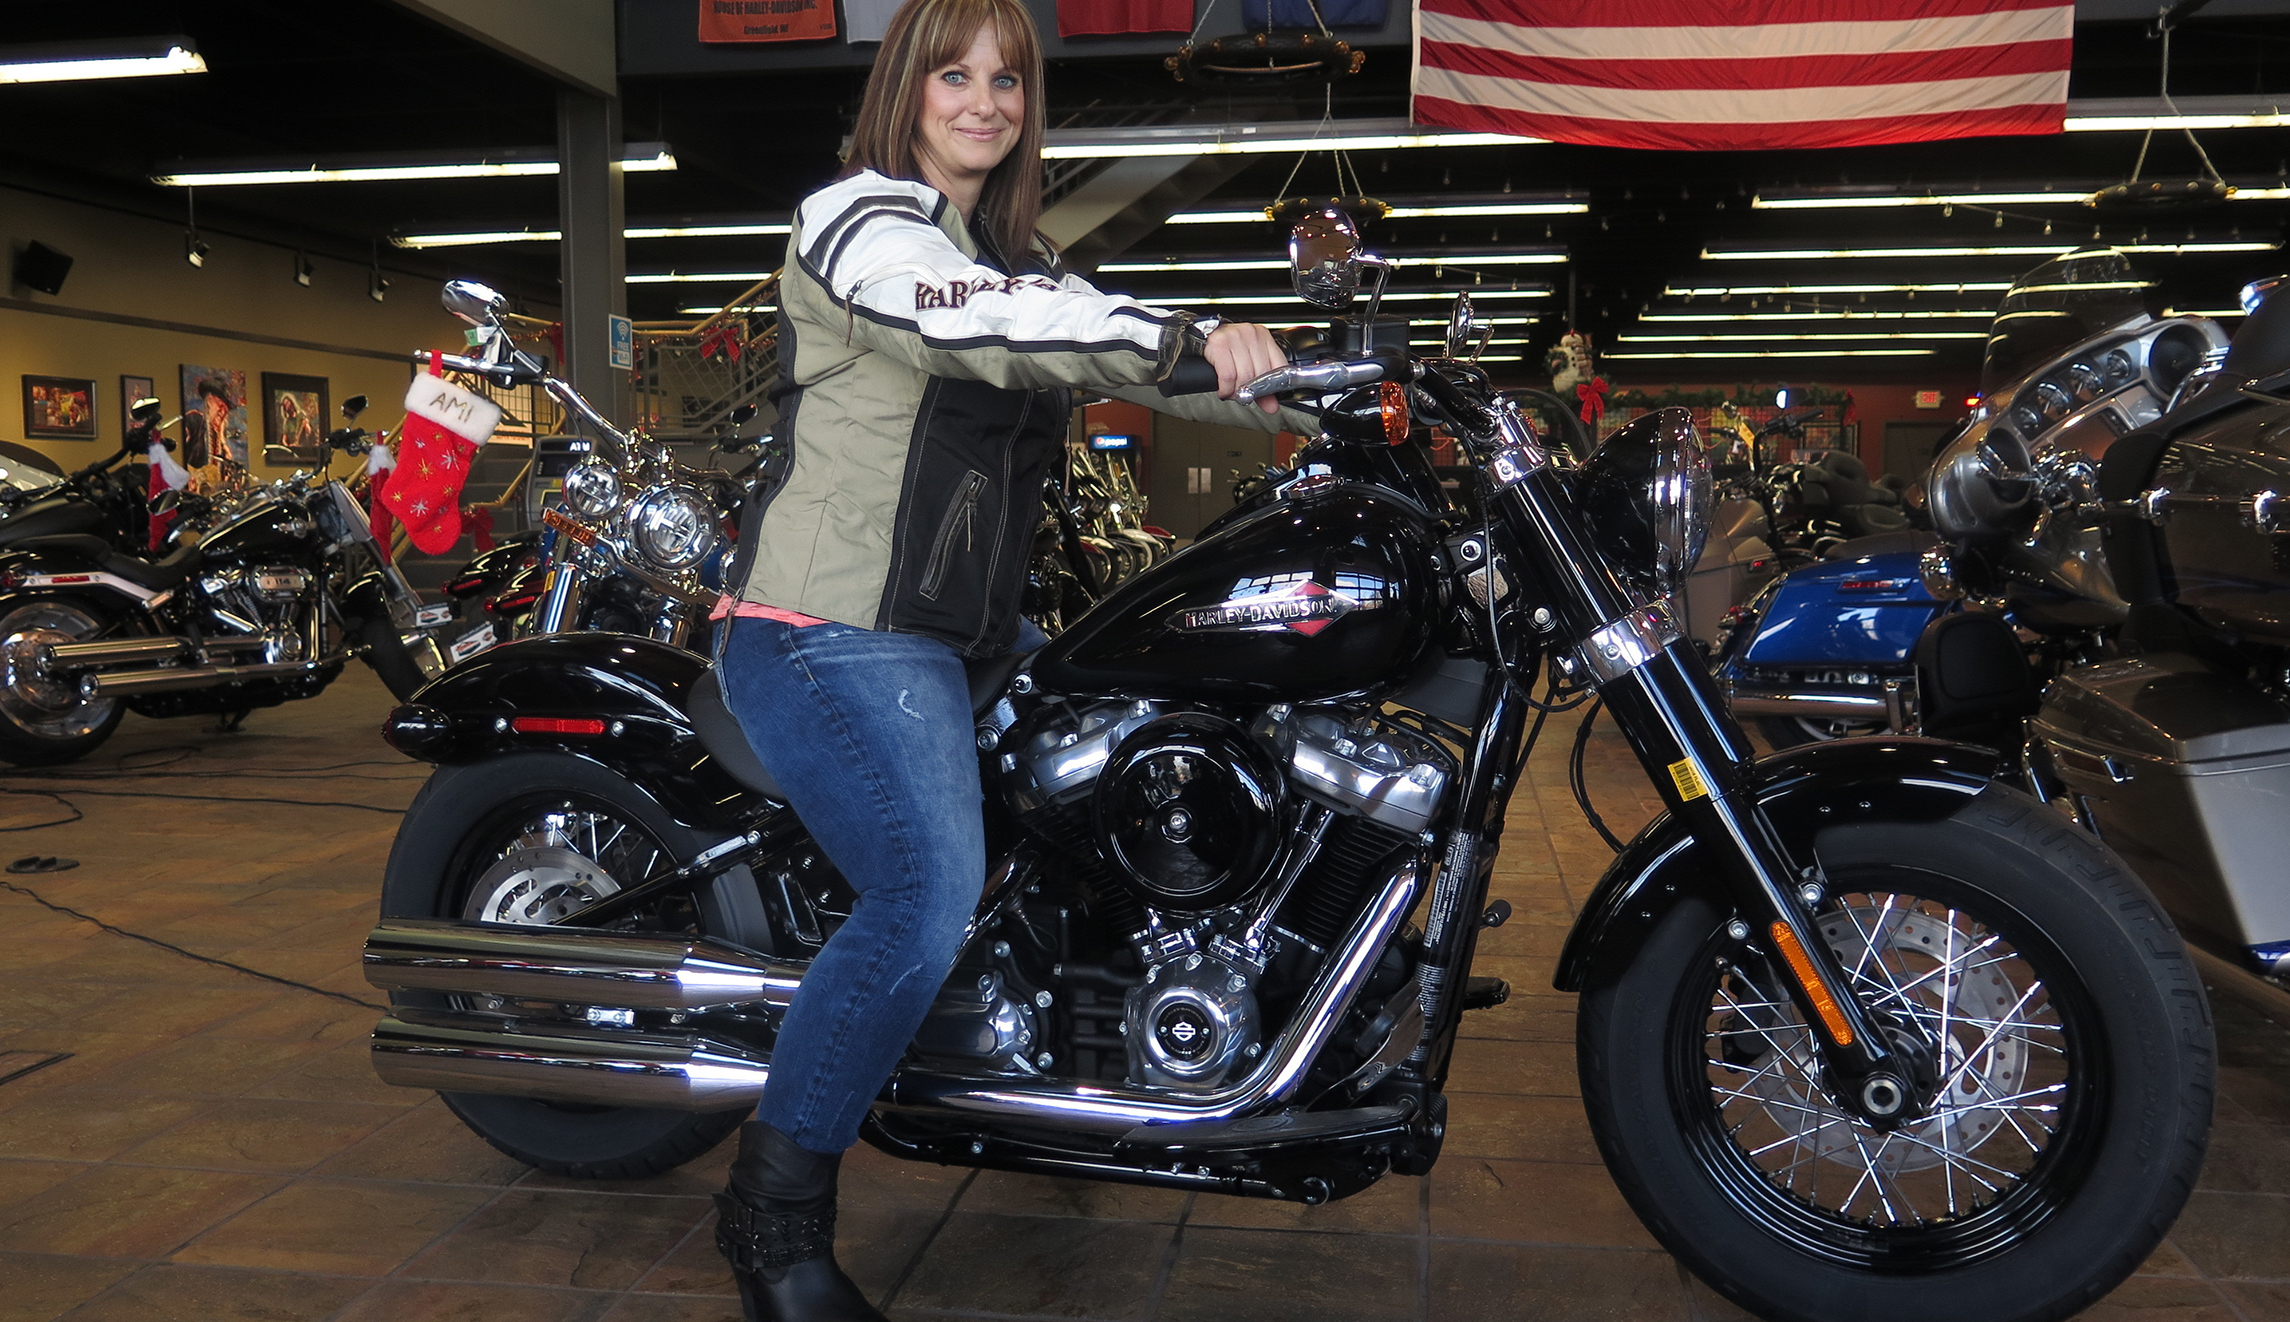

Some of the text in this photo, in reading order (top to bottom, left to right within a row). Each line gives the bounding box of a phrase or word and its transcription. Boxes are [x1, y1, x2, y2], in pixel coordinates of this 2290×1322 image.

[713, 1, 735, 14] HOUSE
[744, 0, 803, 15] HARLEY-DAVIDSON
[617, 341, 630, 351] FREE
[429, 392, 475, 423] AMI
[569, 441, 590, 451] ATM
[1105, 437, 1127, 446] pepsi
[1185, 599, 1339, 628] HARLEY-DAVIDSON
